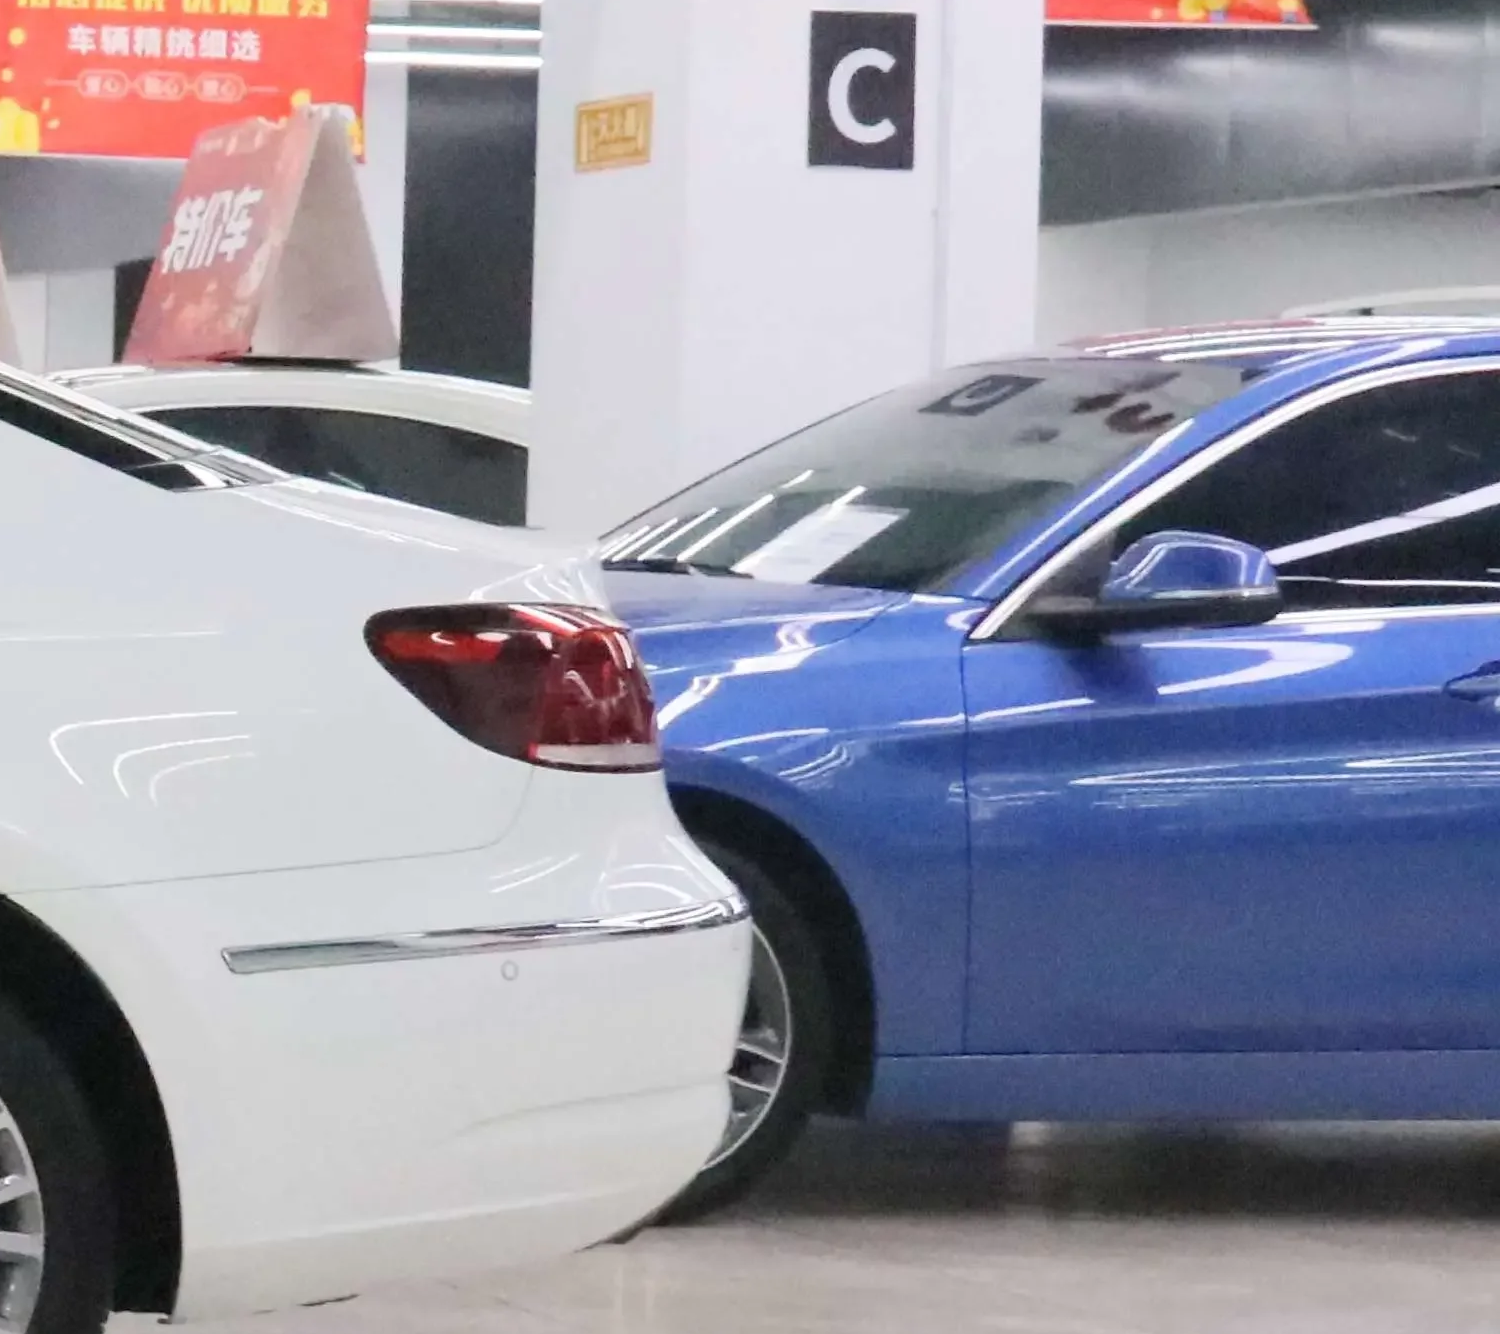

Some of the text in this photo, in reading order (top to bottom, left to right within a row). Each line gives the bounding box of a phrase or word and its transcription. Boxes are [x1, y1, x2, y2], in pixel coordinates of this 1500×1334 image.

[67, 23, 262, 62] 车辆精挑细选
[827, 48, 896, 144] C
[165, 185, 263, 274] 特价车
